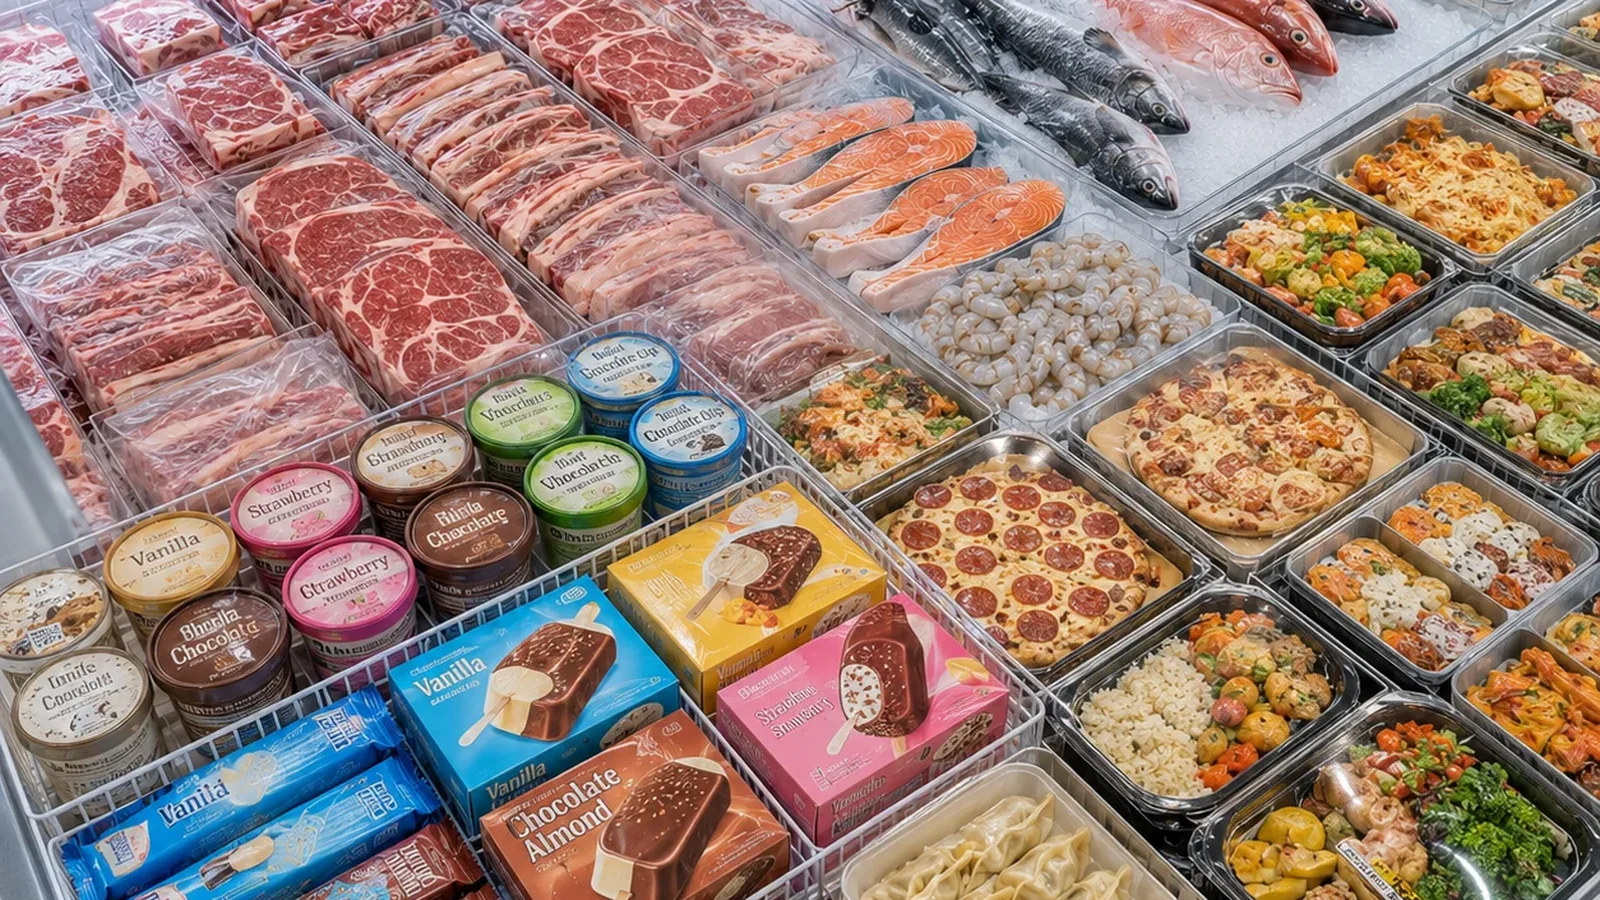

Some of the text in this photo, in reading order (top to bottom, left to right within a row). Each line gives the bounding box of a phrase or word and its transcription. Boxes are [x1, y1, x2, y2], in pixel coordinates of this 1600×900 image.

[247, 480, 333, 519] Strawberry
[130, 534, 201, 566] Vanilla
[412, 658, 488, 697] Vanilla
[486, 763, 547, 800] Vanilla
[506, 768, 621, 839] Chocolate
[523, 798, 613, 864] Almond
